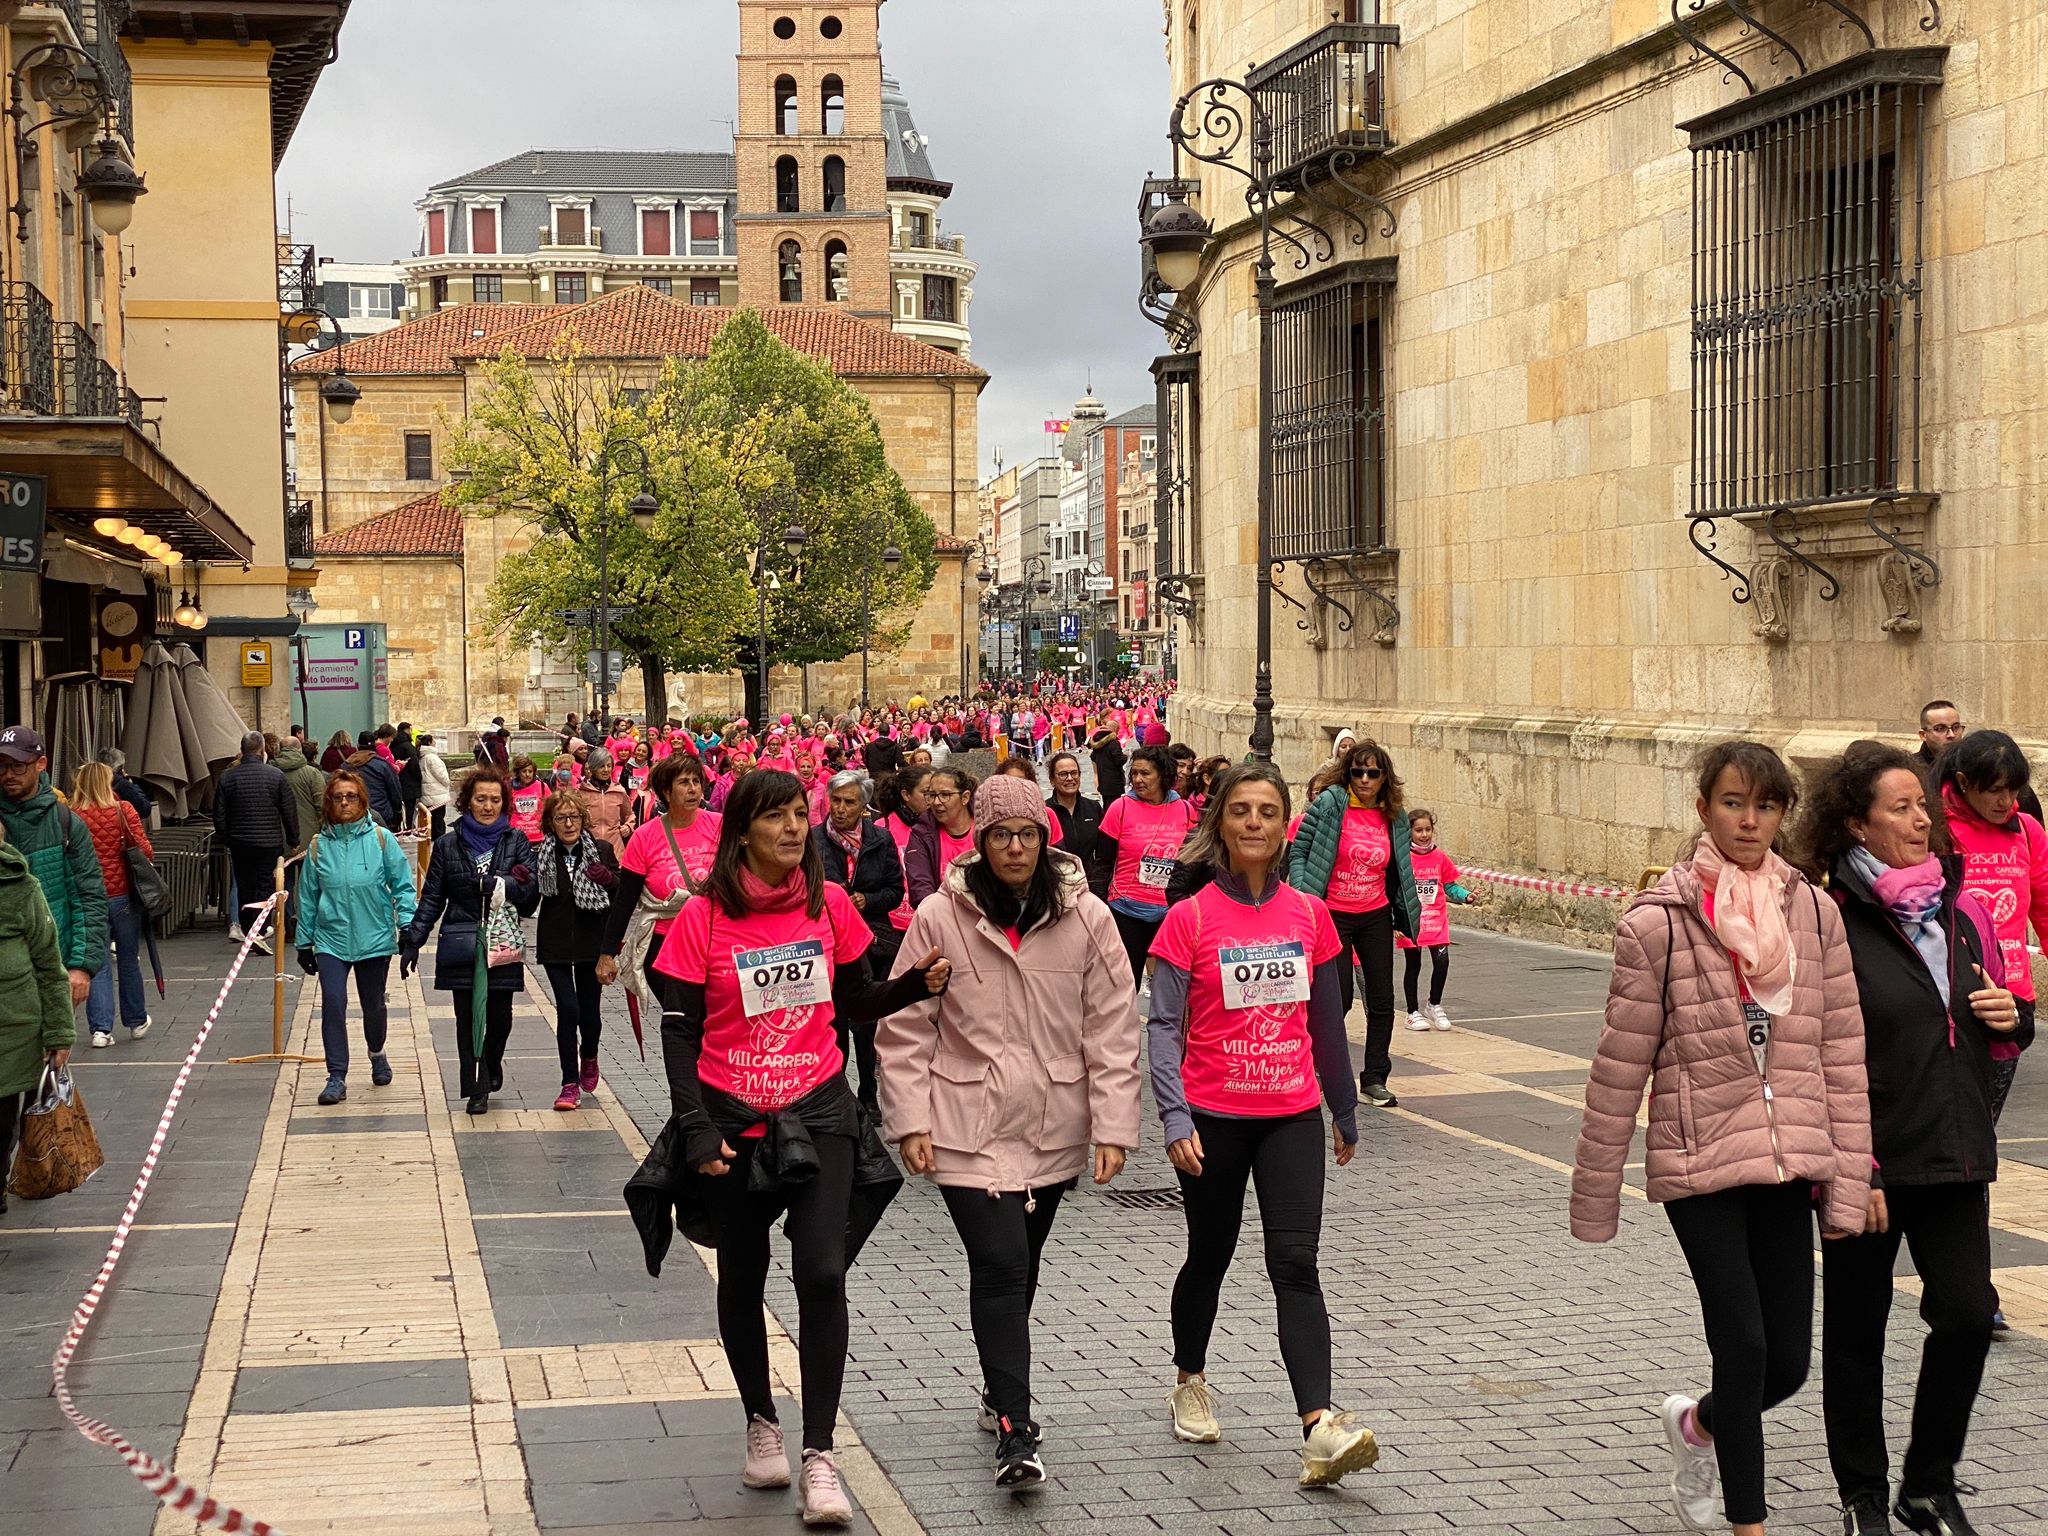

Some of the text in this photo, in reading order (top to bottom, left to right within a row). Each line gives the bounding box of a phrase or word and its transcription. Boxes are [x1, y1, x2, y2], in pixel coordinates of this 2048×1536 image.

[0, 537, 34, 564] ES
[348, 630, 361, 648] P
[296, 675, 355, 685] Snto Domingo
[1144, 863, 1172, 876] 3770
[1417, 886, 1435, 895] 586
[763, 945, 797, 956] GRUPO
[1999, 939, 2021, 950] RERA
[764, 948, 815, 963] solitium
[1247, 950, 1296, 960] solitium
[753, 959, 814, 988] 0787
[1234, 960, 1297, 983] 0788
[1223, 1039, 1248, 1055] VIII
[728, 1048, 751, 1067] VIII
[1240, 1058, 1295, 1083] Mujer
[743, 1071, 801, 1097] Mujer
